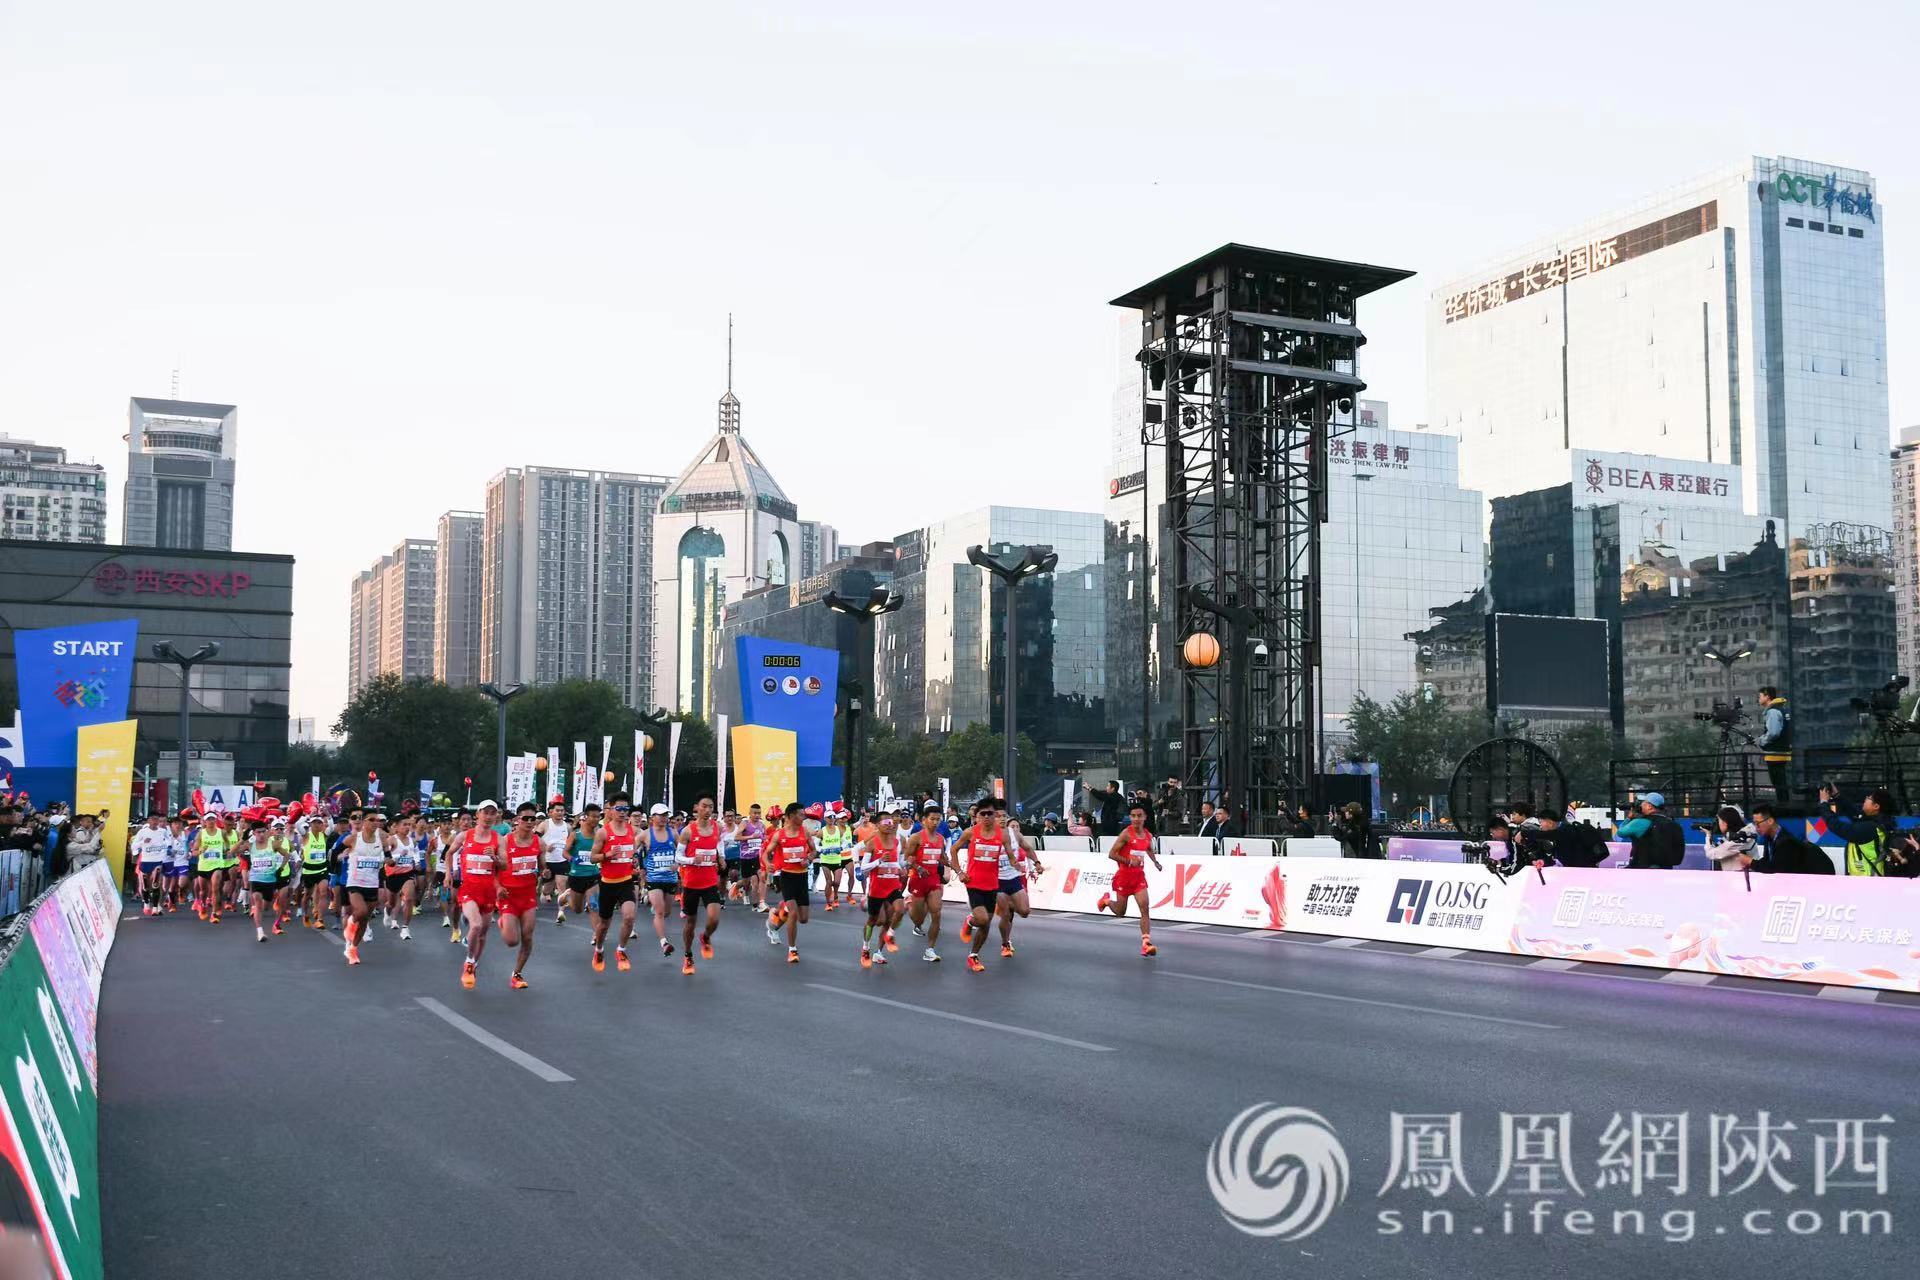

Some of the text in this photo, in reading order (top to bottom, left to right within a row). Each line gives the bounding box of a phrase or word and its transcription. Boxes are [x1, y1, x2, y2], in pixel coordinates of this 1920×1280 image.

[1776, 173, 1822, 206] OCT
[1329, 438, 1410, 464] 洪振律师
[1329, 457, 1351, 465] HONG
[135, 566, 252, 598] 西安SKP
[53, 640, 123, 657] START
[764, 656, 800, 667] 0:00:06
[210, 789, 225, 805] A
[238, 789, 248, 809] A
[1185, 881, 1232, 910] 特步
[1306, 883, 1360, 905] 助力打破
[1592, 894, 1628, 909] PICC
[1427, 912, 1484, 931] 曲江体育集团
[1587, 909, 1665, 929] 中国人民保险
[1812, 903, 1859, 923] PICC
[1807, 924, 1913, 946] 中国人民保险
